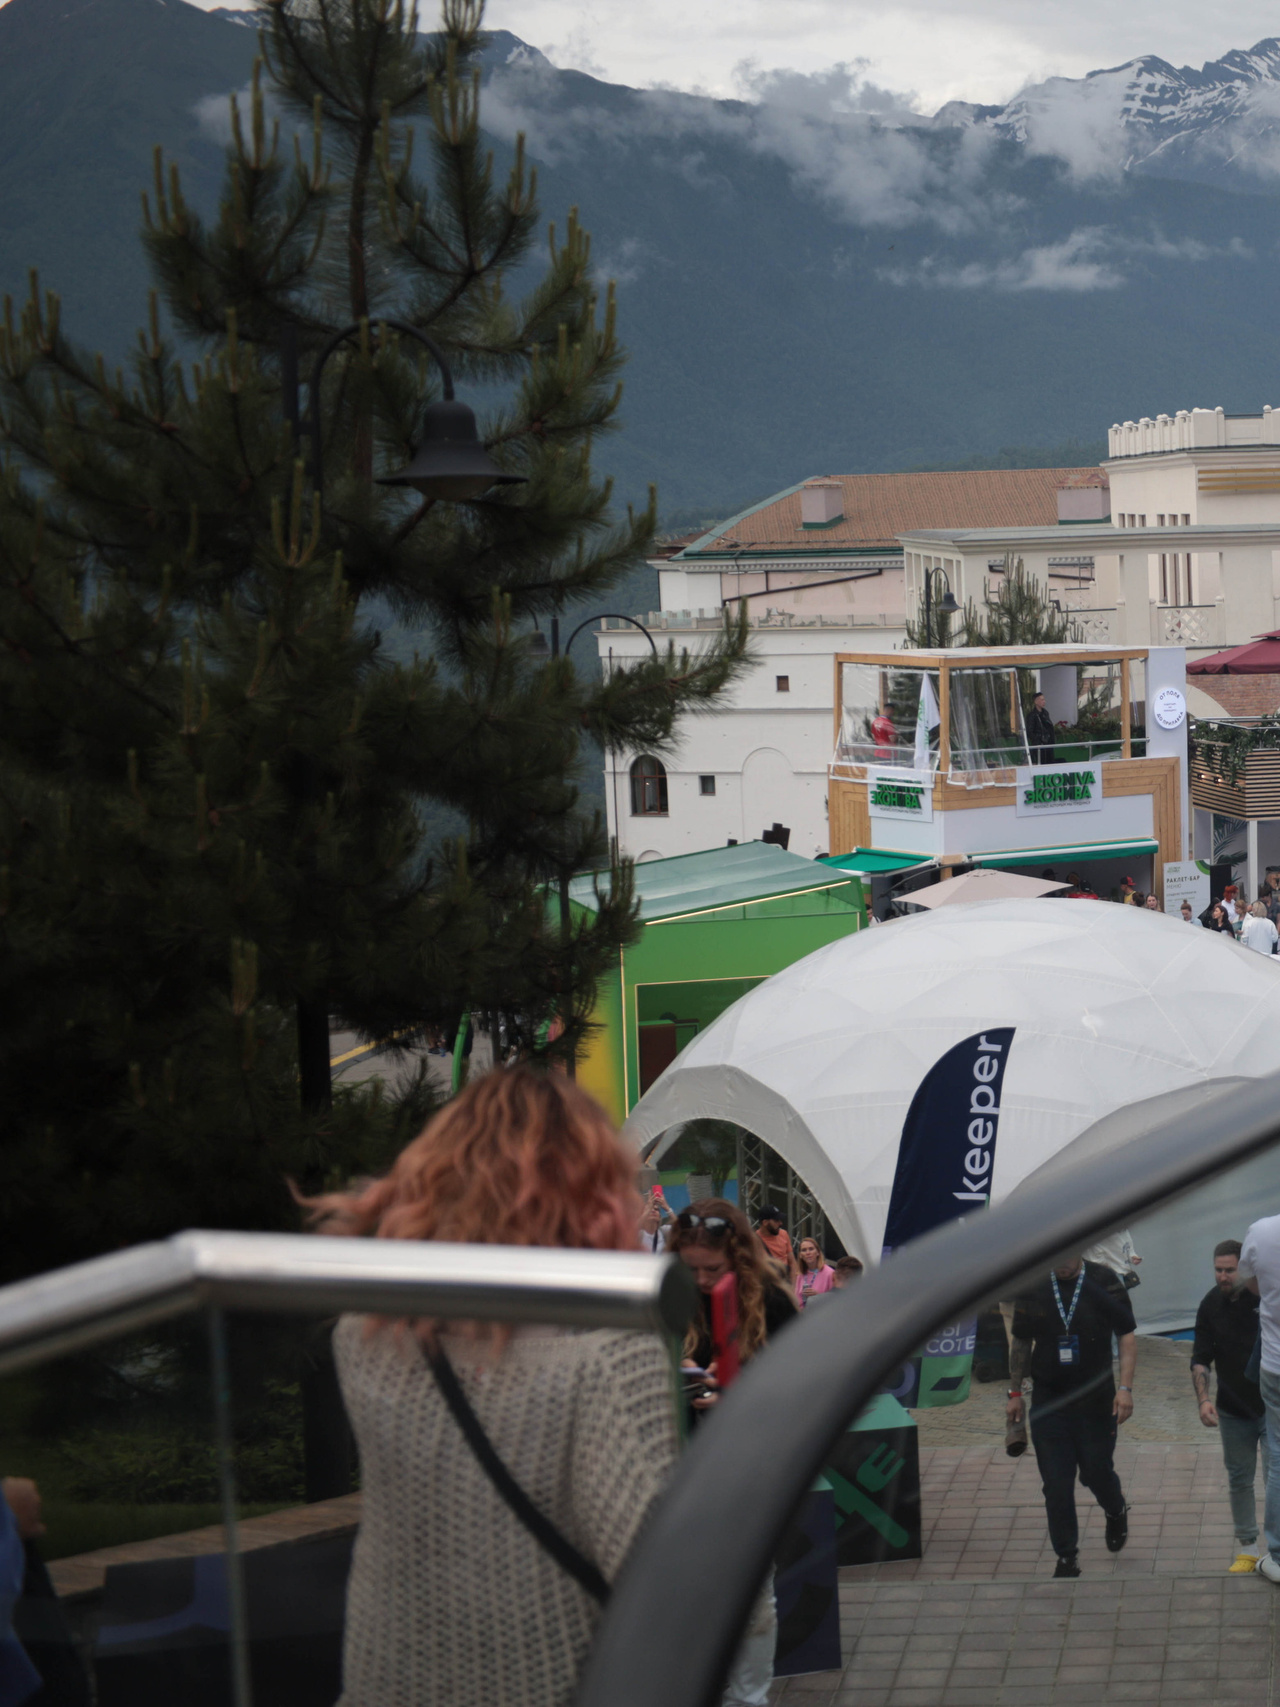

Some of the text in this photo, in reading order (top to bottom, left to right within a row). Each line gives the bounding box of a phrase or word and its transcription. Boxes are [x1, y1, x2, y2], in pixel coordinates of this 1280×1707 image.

[1033, 771, 1096, 789] EKONIVA
[1024, 785, 1092, 805] ЭКОНИВА
[952, 1034, 1003, 1201] keeper
